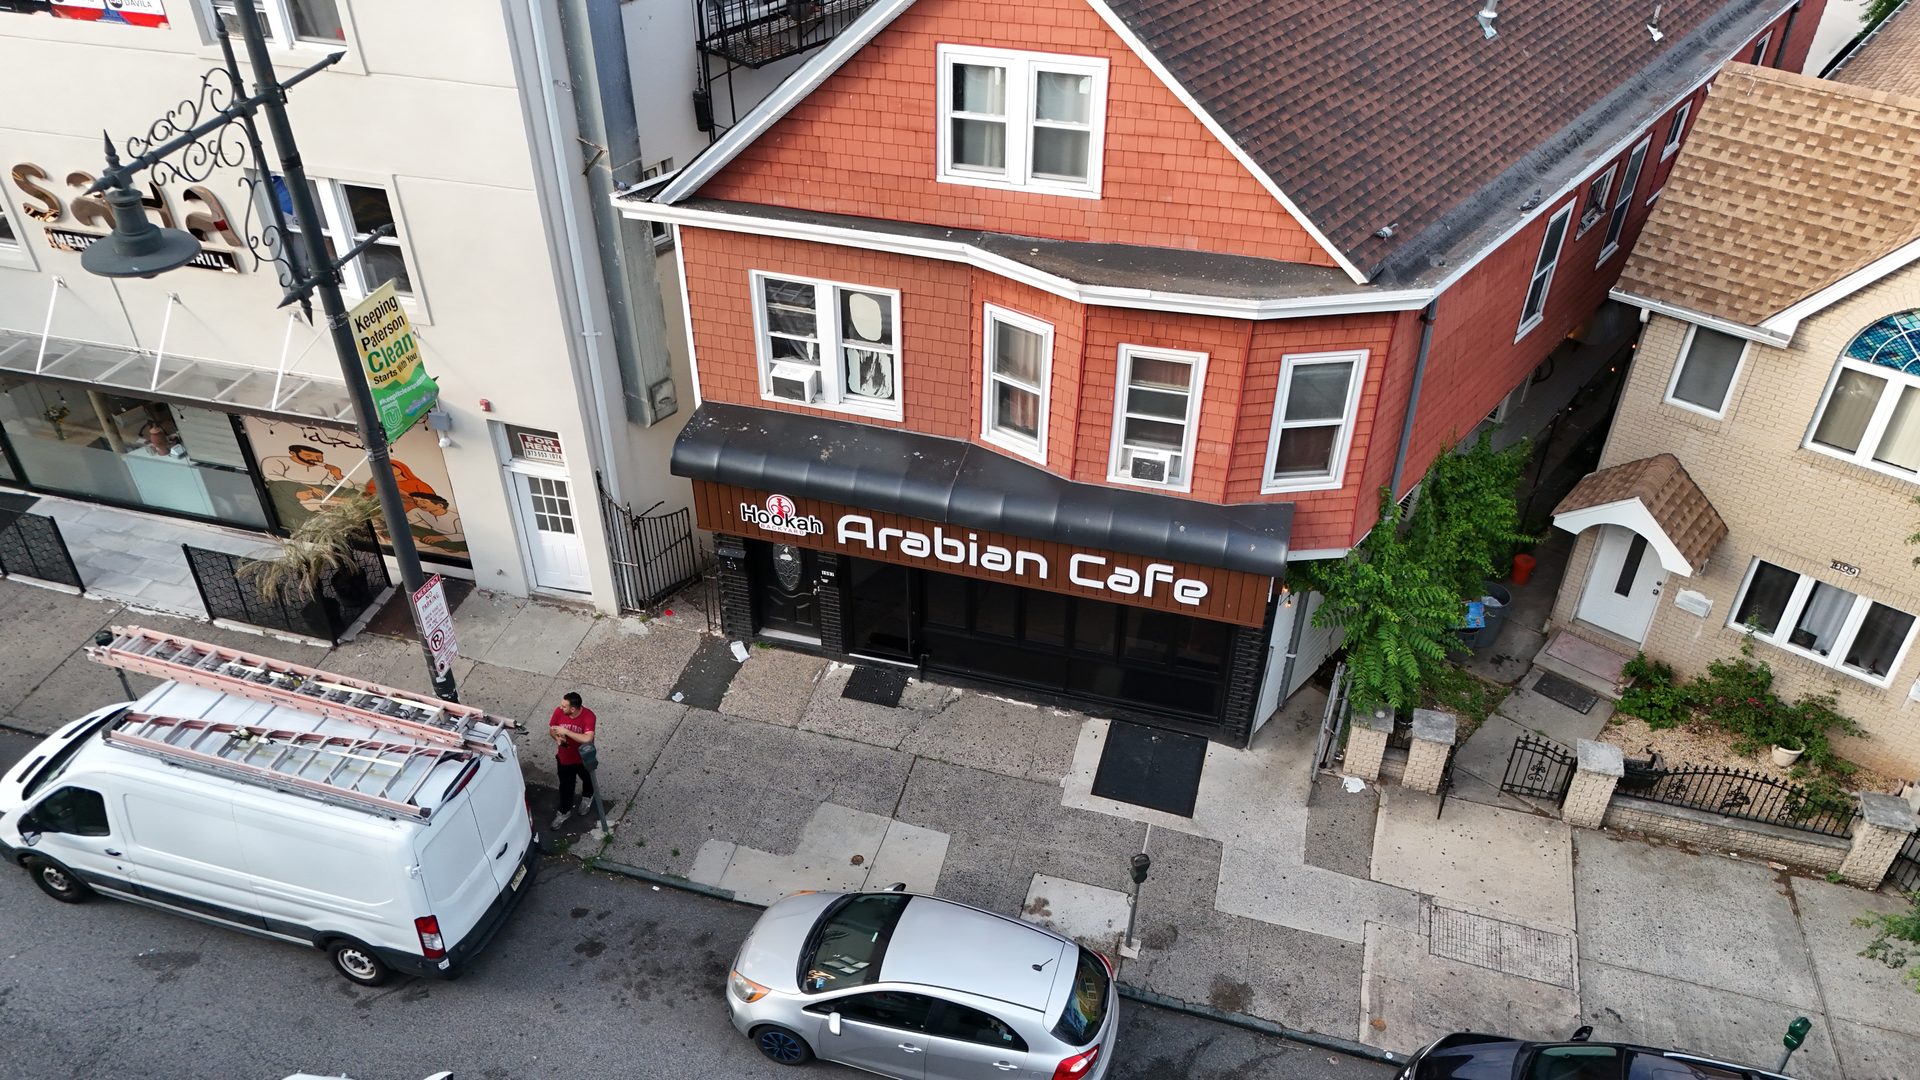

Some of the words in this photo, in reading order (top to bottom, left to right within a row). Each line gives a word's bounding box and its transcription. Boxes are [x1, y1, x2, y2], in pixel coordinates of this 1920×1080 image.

[354, 295, 399, 333] Keeping
[361, 314, 405, 351] Paterson
[367, 333, 414, 373] Clean
[373, 369, 398, 385] Starts
[406, 352, 418, 364] You
[525, 442, 560, 453] RENT
[526, 436, 554, 446] FOR
[741, 504, 822, 534] Hookah
[760, 523, 805, 536] BACKYARD
[837, 514, 1047, 579] Arabian
[1069, 553, 1208, 605] Cafe
[415, 576, 440, 602] EMERGENCY
[422, 592, 440, 612] PARKING
[425, 591, 433, 601] NO
